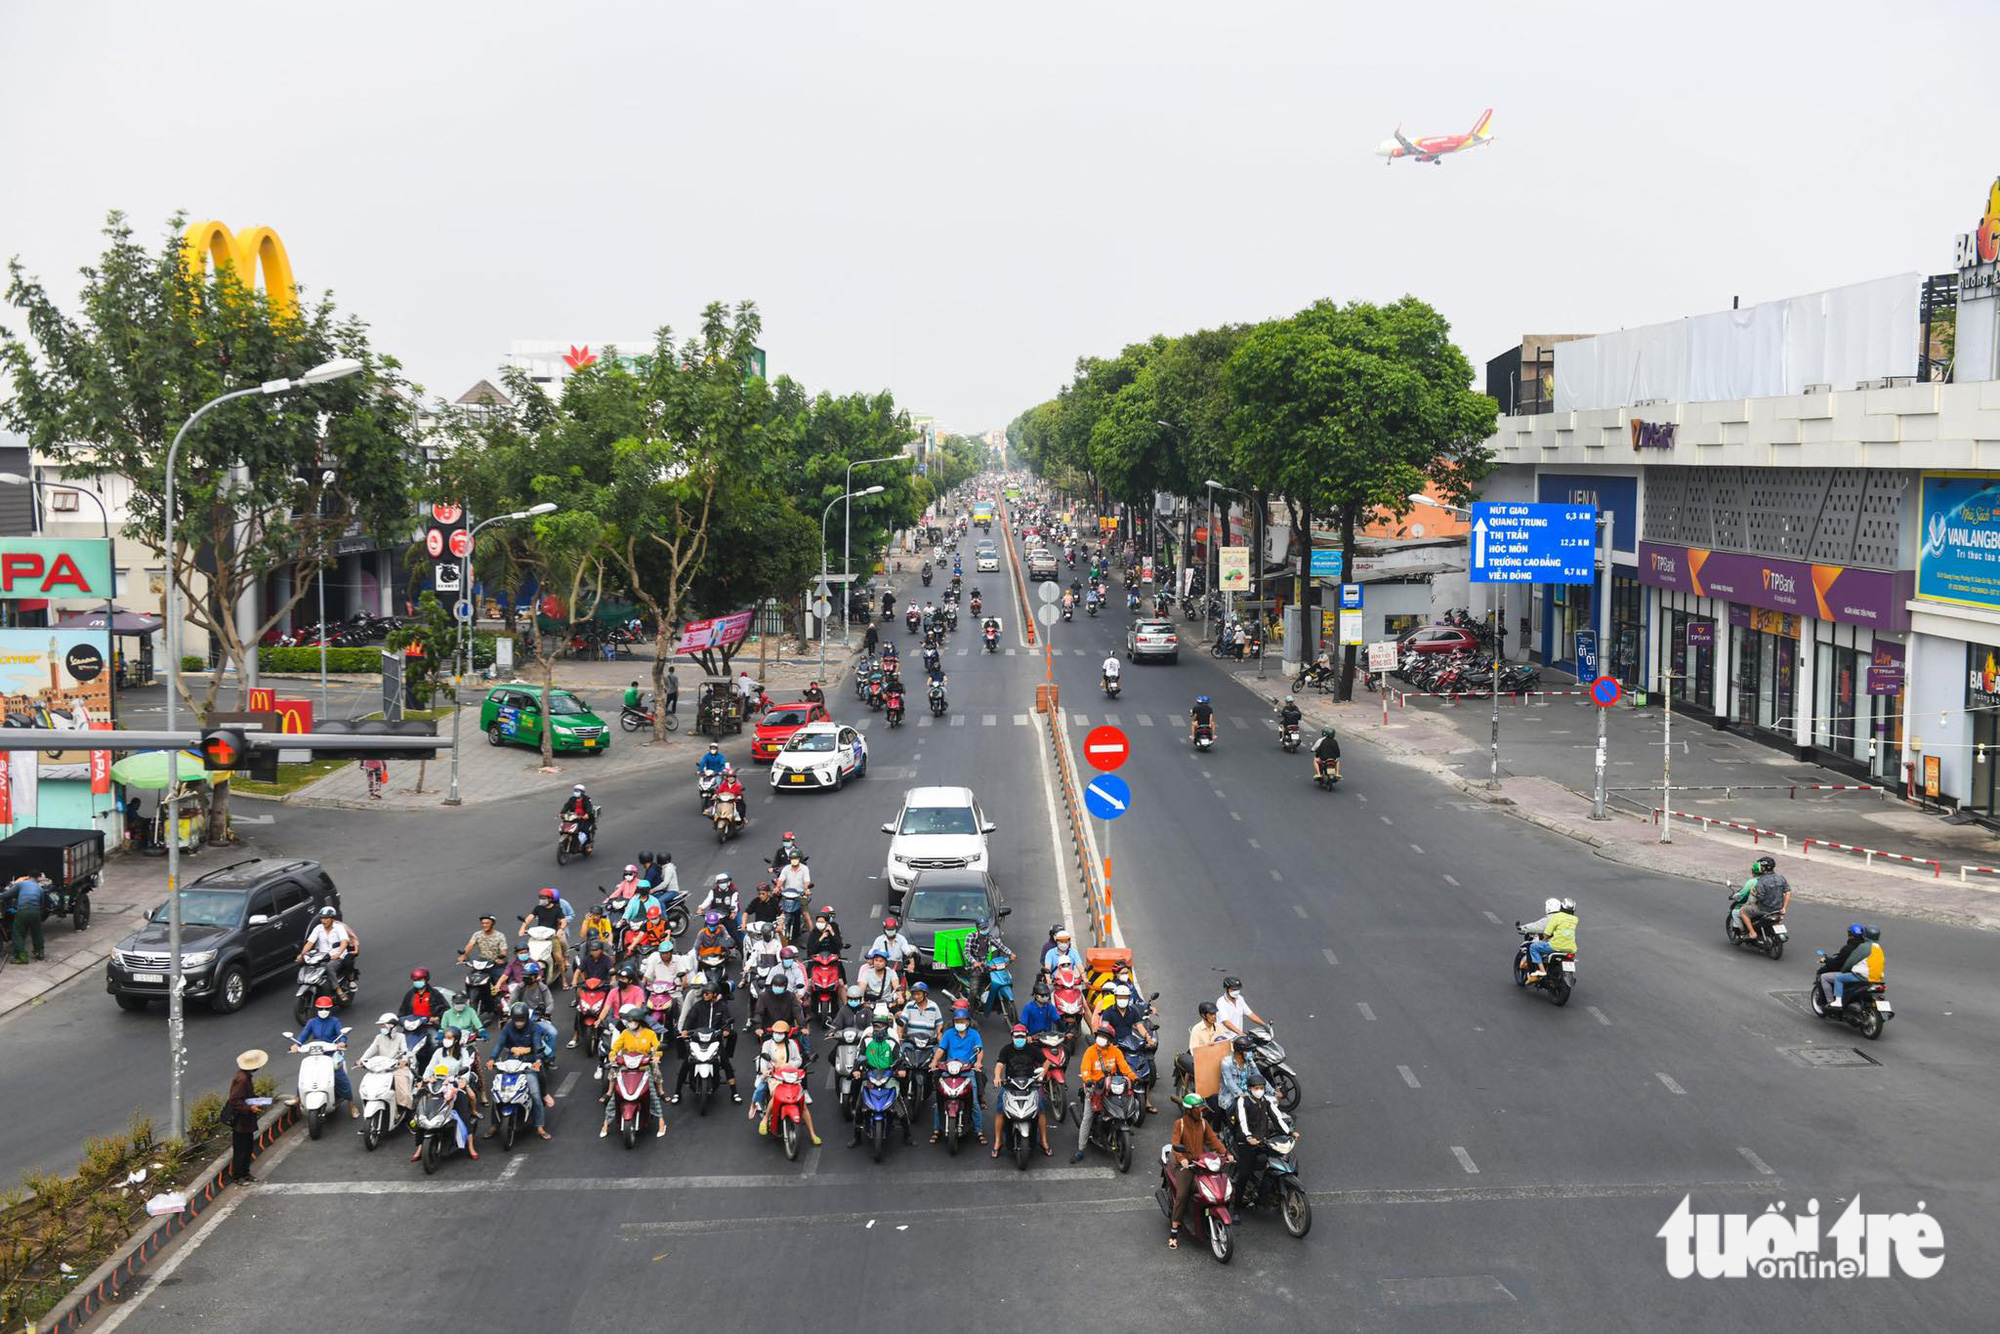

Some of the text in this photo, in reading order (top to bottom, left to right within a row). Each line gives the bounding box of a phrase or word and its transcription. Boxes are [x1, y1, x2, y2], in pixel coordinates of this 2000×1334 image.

[1490, 503, 1529, 515] NÚT GIAO
[1565, 512, 1591, 521] 6,3 KM
[1489, 518, 1547, 527] QUANG TRUNG
[1490, 531, 1504, 541] THỊ
[1947, 527, 2000, 550] VANLANGB
[1489, 542, 1528, 553] HÓC MÔN
[1560, 538, 1590, 547] 12,2 KM
[1523, 559, 1539, 567] CAO
[1657, 555, 1676, 573] TPBank
[1564, 567, 1588, 576] 6,7 KM
[1771, 572, 1796, 593] TPBank
[1578, 647, 1587, 657] 01
[1586, 655, 1596, 666] 01
